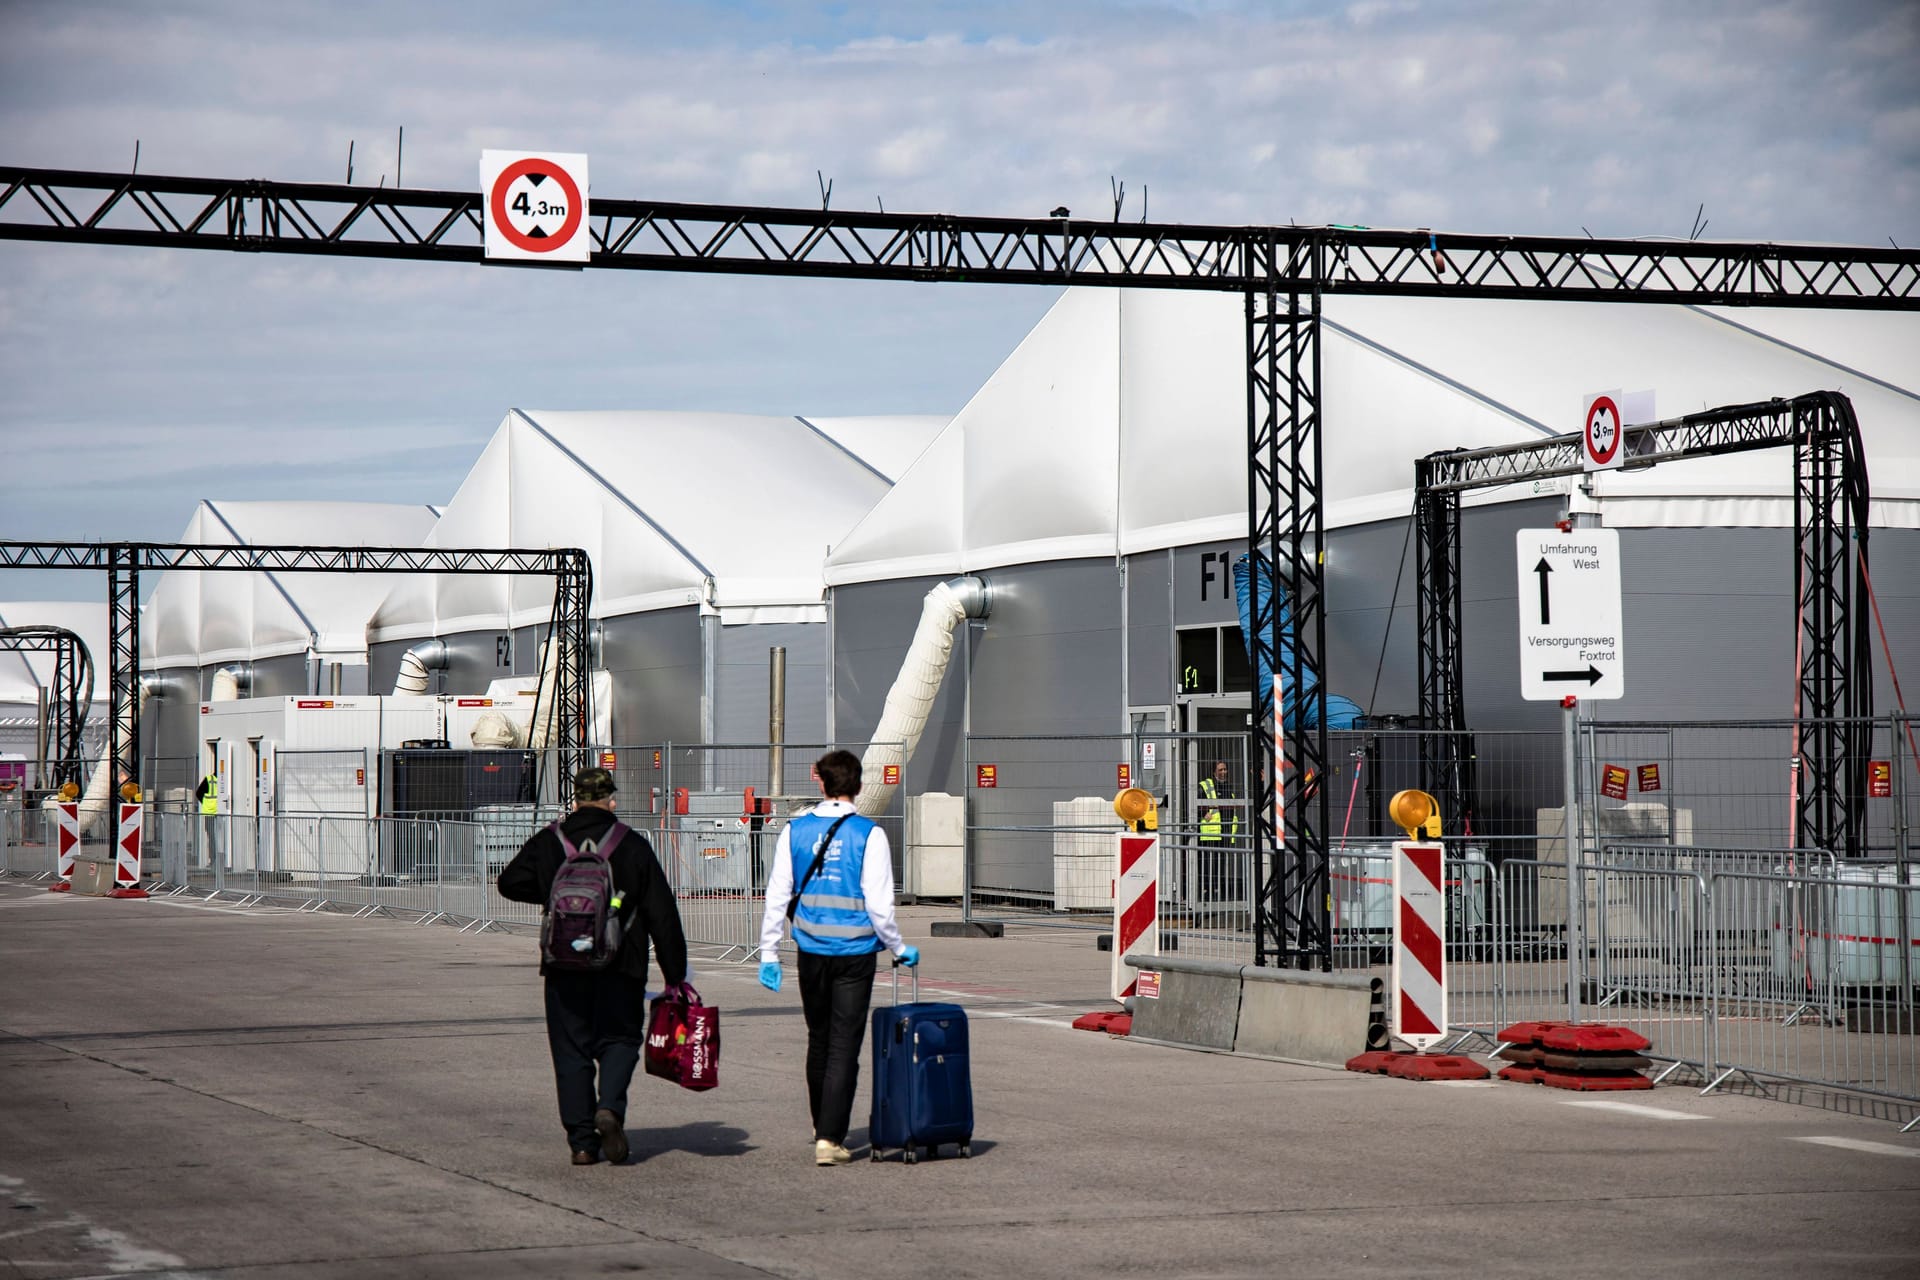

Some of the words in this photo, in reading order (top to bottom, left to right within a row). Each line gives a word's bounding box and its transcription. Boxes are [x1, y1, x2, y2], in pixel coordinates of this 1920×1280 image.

[511, 191, 565, 217] 4,3m
[1593, 421, 1614, 439] 3,9m
[1540, 544, 1598, 556] Umfahrung
[1573, 559, 1600, 569] West
[1201, 551, 1229, 601] F1
[496, 636, 510, 667] F2
[1528, 636, 1615, 648] Versorgungsweg
[1579, 651, 1616, 661] Foxtrot
[1185, 666, 1198, 688] F1
[692, 1016, 706, 1079] ROSSMANN
